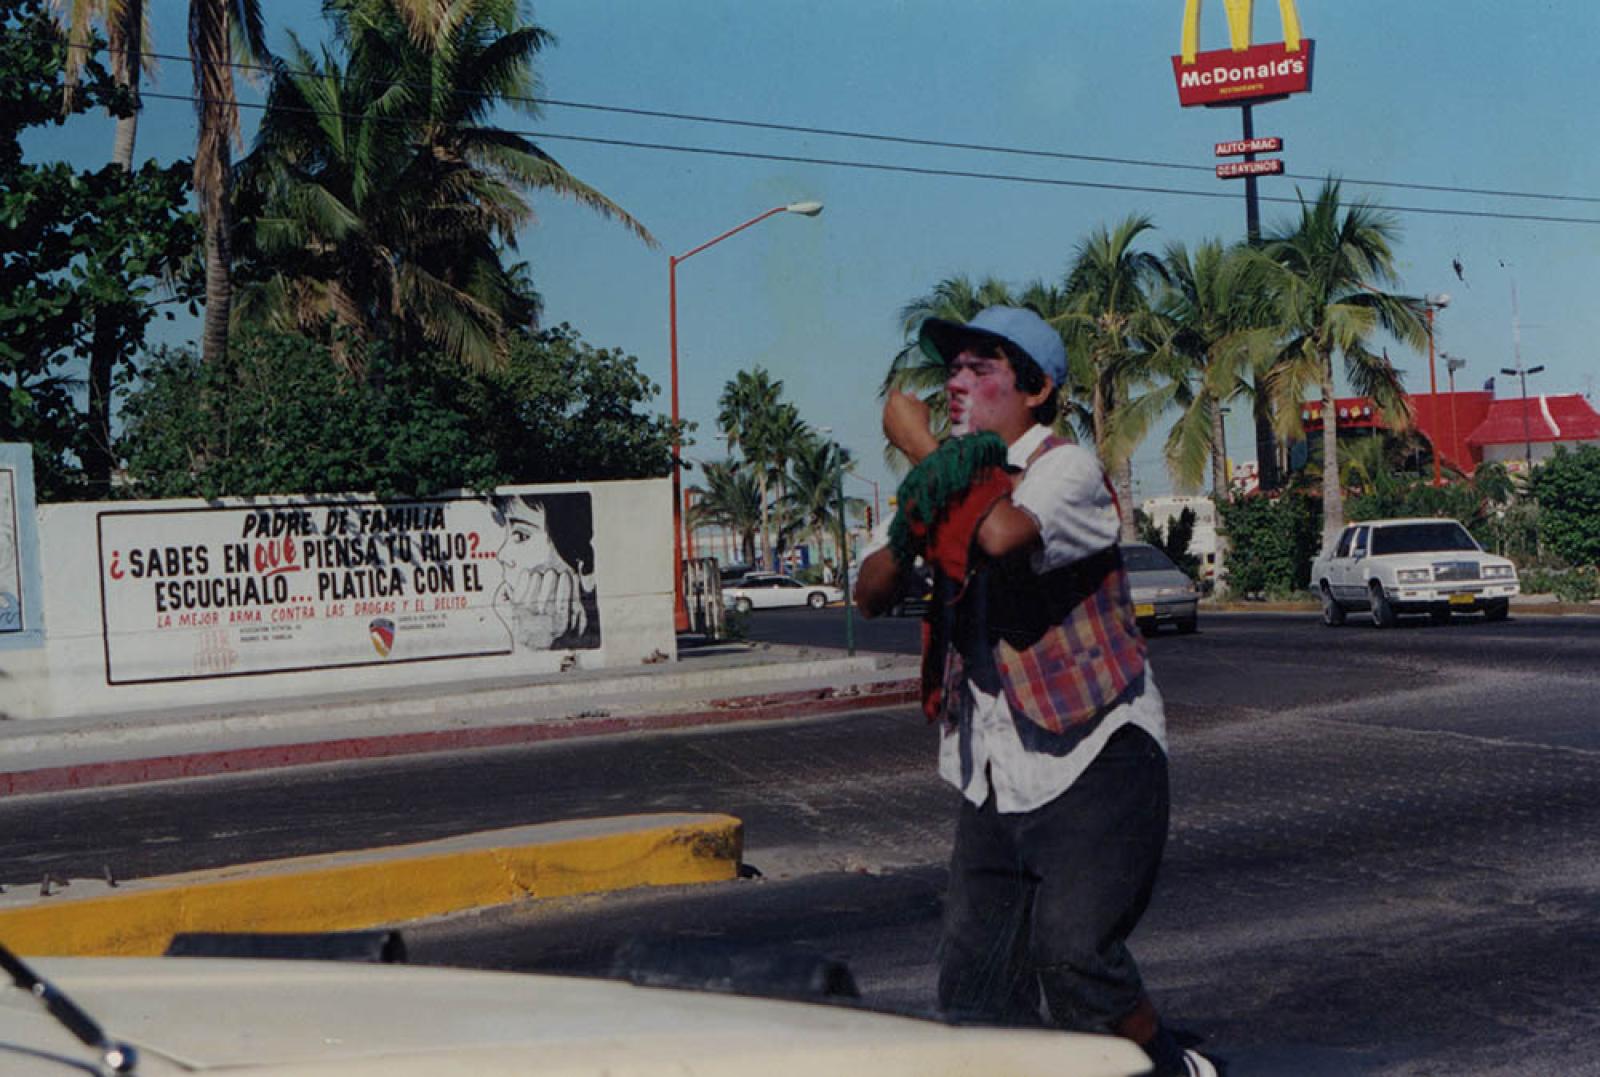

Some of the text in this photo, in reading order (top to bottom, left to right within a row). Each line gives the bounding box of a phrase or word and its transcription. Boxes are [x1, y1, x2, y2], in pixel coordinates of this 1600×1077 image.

[1181, 60, 1304, 88] McDonald's
[1216, 138, 1277, 154] AUTO-MAC
[242, 507, 445, 538] PADRE DE FAMILIA
[223, 543, 249, 573] EN
[303, 536, 379, 568] PIENSA
[386, 533, 412, 563] TU
[318, 568, 404, 600] PLATICA
[414, 563, 455, 595] CON
[463, 563, 483, 593] EL
[157, 614, 172, 629] LA
[179, 611, 219, 627] MEJOR
[229, 609, 262, 624] ARMA
[271, 605, 315, 623] CONTRA
[325, 603, 345, 617] LAS
[354, 600, 396, 616] DROGAS
[402, 600, 409, 611] Y
[415, 599, 425, 612] EL
